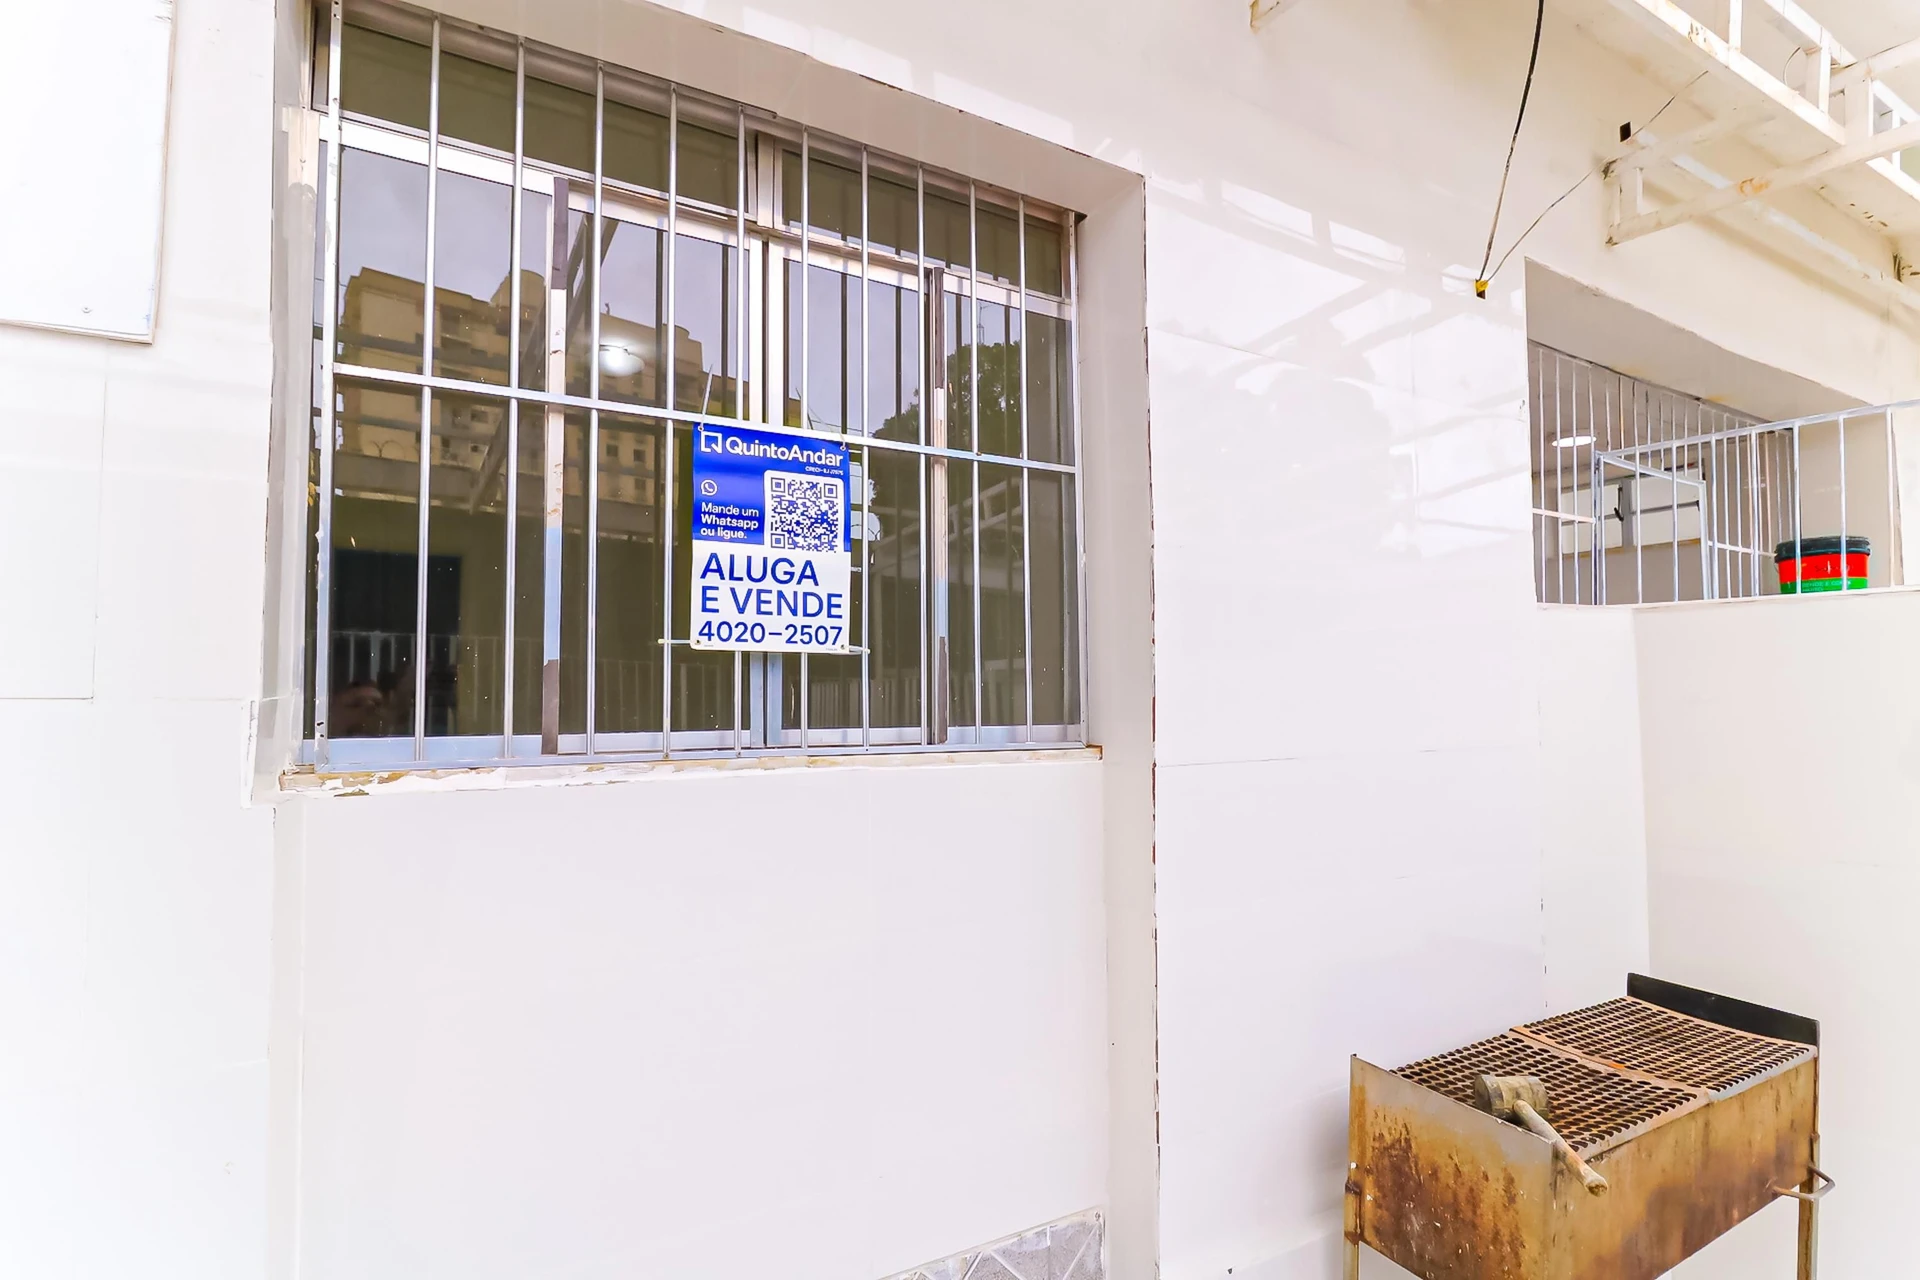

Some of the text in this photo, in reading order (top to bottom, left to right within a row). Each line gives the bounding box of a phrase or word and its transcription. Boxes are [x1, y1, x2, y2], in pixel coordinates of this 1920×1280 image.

[725, 436, 843, 467] QuintoAndar
[701, 501, 759, 517] Mande um
[701, 513, 759, 531] Whatsapp
[700, 526, 748, 540] ou ligue.
[700, 552, 819, 587] ALUGA
[701, 585, 843, 619] E VENDE
[698, 620, 843, 646] 4020-2507
